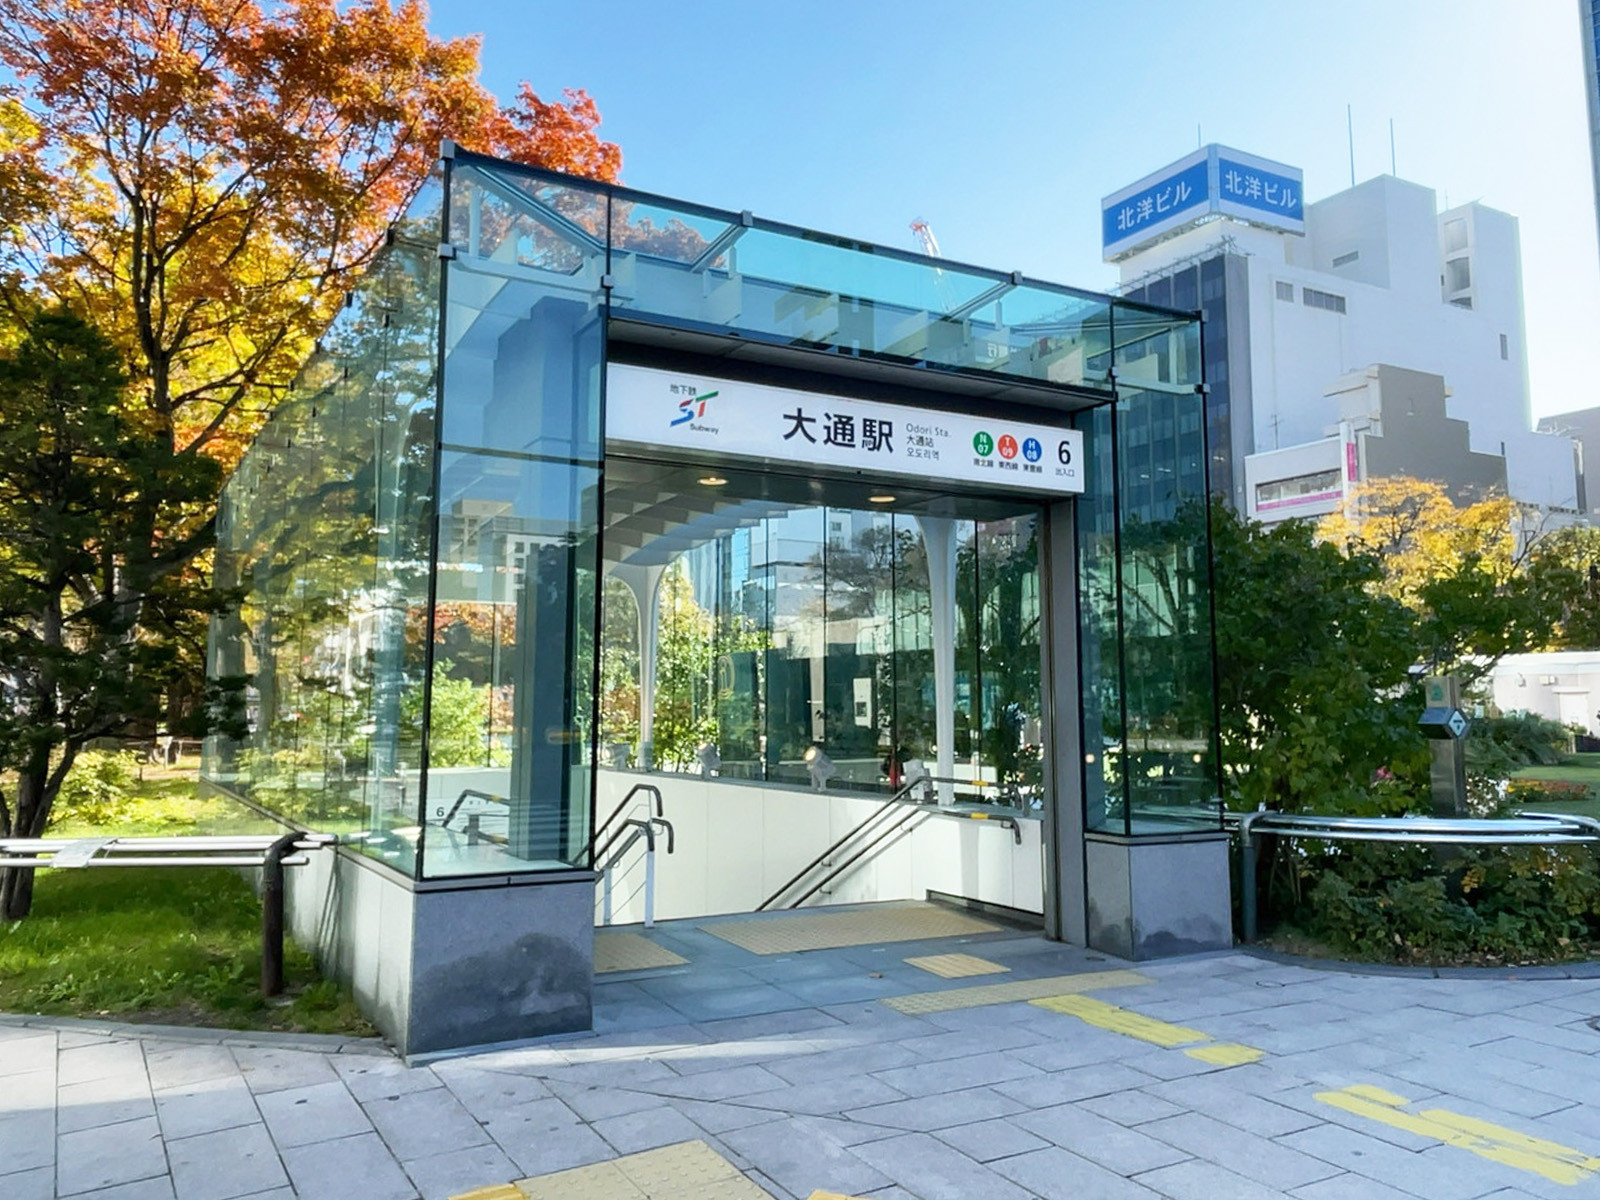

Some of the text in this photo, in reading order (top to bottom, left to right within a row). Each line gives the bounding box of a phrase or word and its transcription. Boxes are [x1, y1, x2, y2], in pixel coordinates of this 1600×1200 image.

[1225, 170, 1297, 208] 北洋ビル
[1117, 181, 1192, 230] 北洋ビル
[690, 423, 719, 435] Subway
[782, 408, 894, 453] 大通駅
[906, 423, 952, 438] Odori Sta.
[979, 434, 987, 443] N
[1005, 437, 1011, 445] T
[1028, 440, 1036, 448] H
[906, 447, 940, 460] 오도리역
[977, 445, 989, 454] 07
[1002, 447, 1013, 457] 09
[1058, 440, 1071, 465] 6
[1026, 451, 1038, 460] 08
[436, 806, 445, 817] 6
